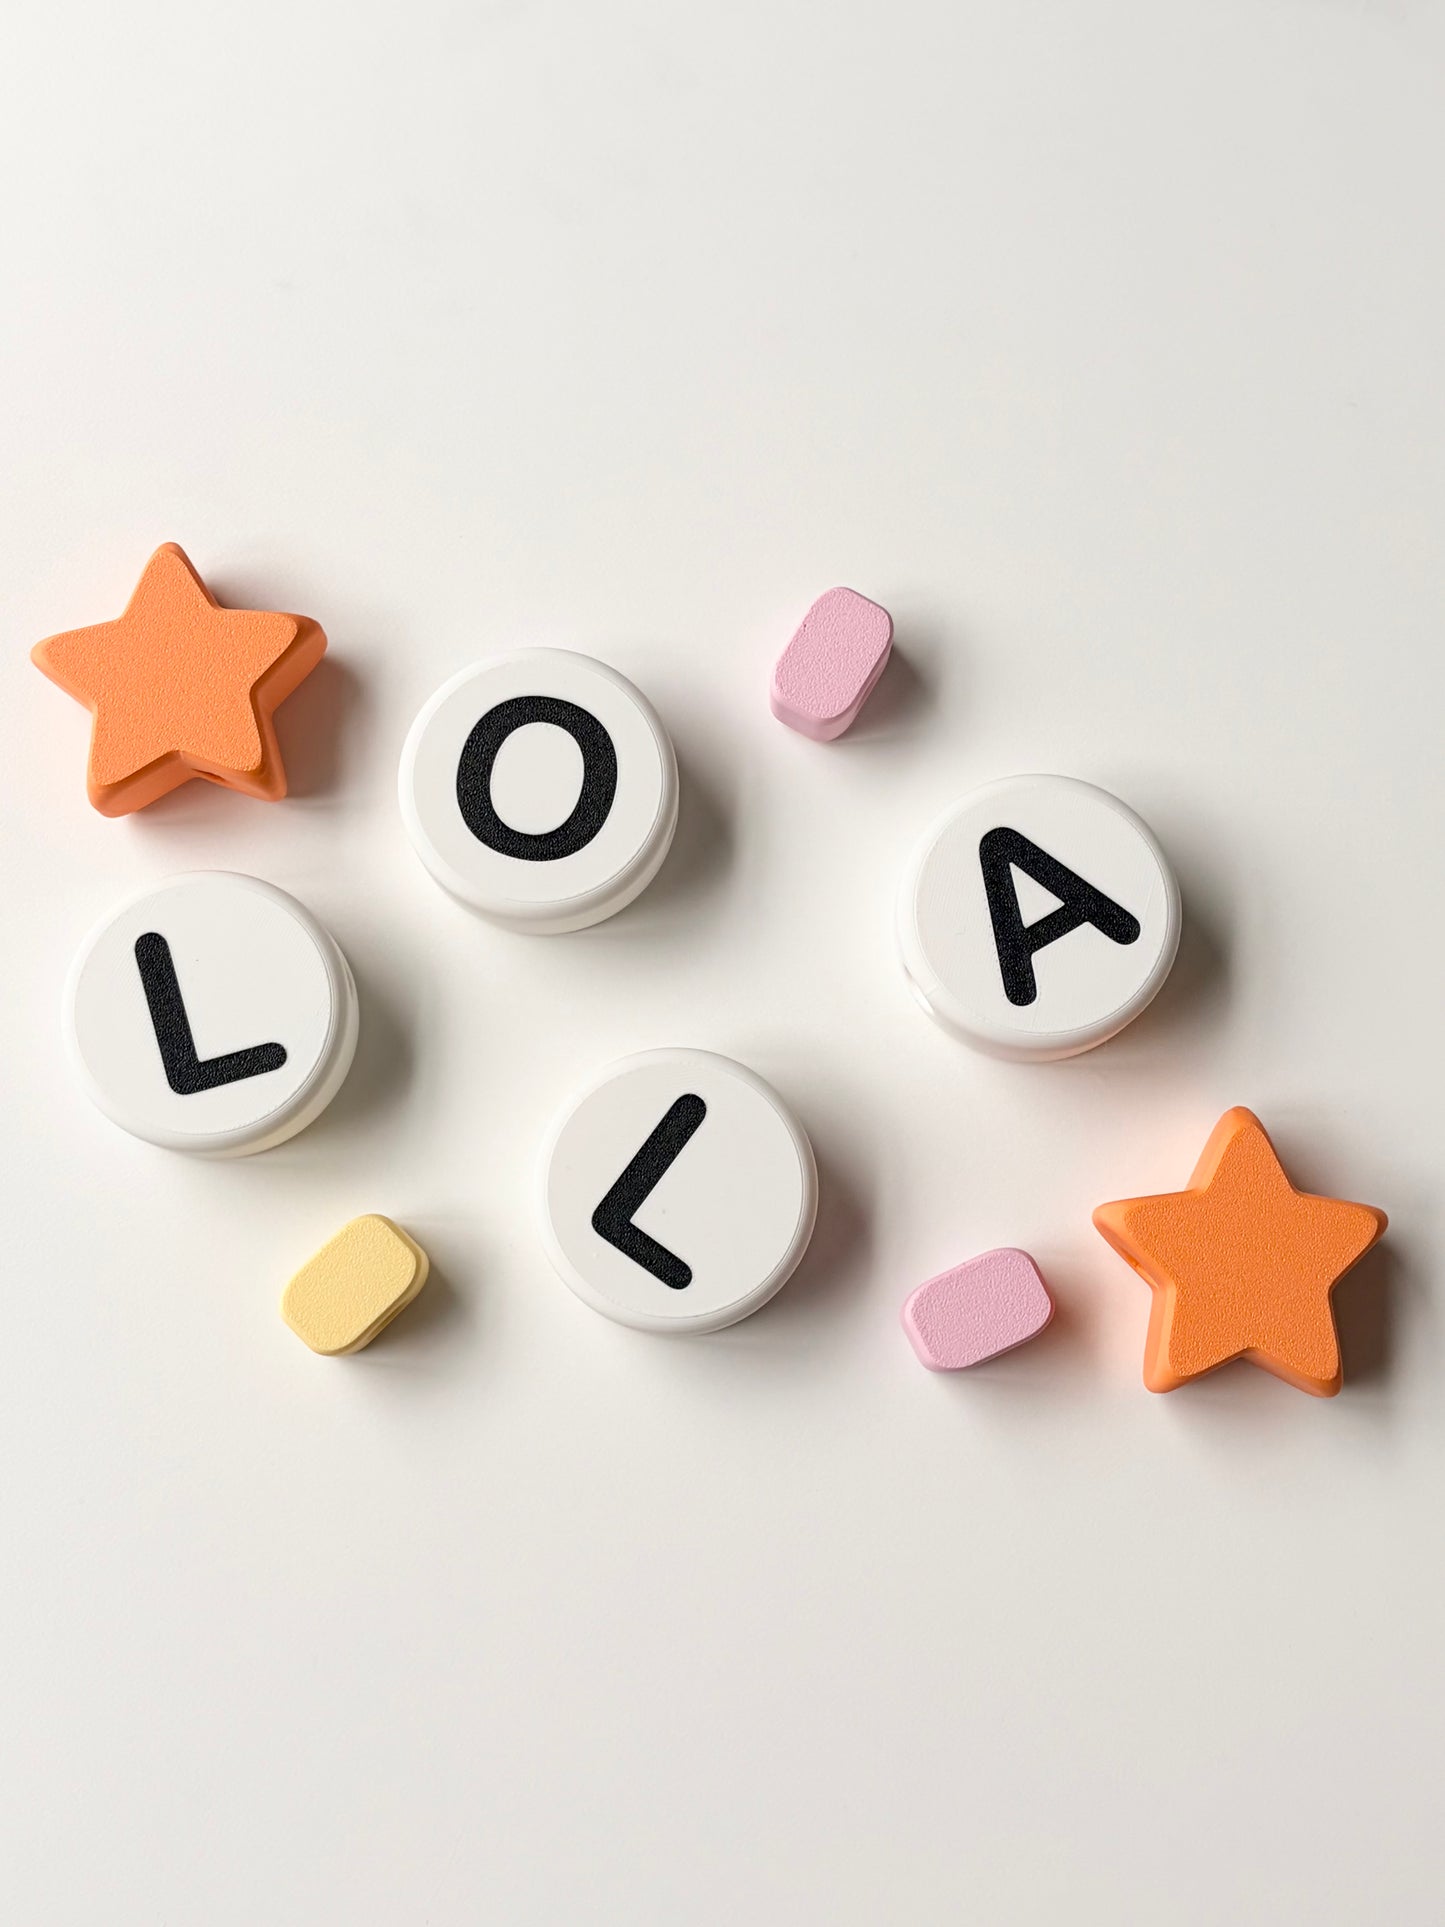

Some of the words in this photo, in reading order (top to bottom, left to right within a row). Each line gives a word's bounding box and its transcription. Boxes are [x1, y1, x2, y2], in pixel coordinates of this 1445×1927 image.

[457, 696, 617, 861] O
[979, 827, 1140, 1006] A
[135, 932, 287, 1095] L
[592, 1094, 708, 1290] L
